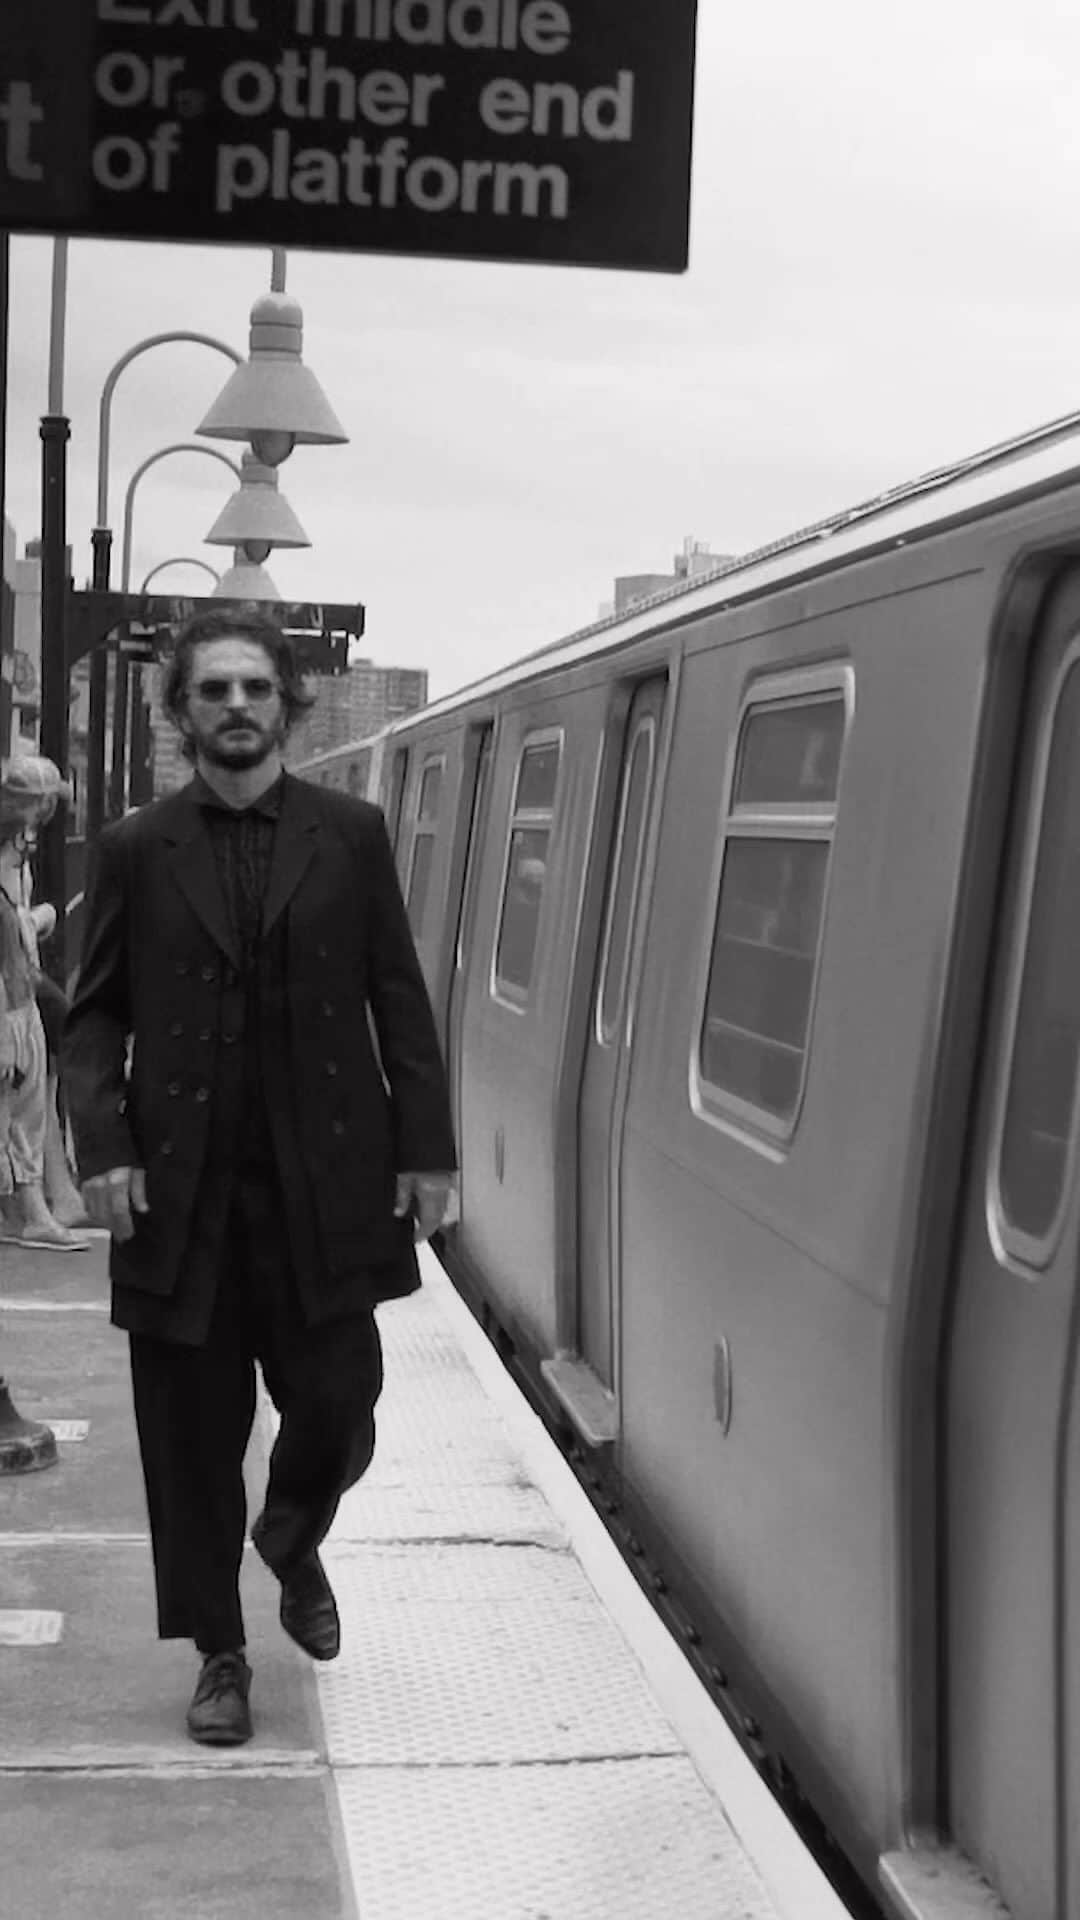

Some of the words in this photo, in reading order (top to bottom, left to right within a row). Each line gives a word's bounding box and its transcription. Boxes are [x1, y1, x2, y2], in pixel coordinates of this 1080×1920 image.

[98, 53, 184, 107] or
[221, 49, 445, 126] other
[479, 69, 635, 141] end
[93, 123, 180, 191] of
[216, 130, 569, 219] platform
